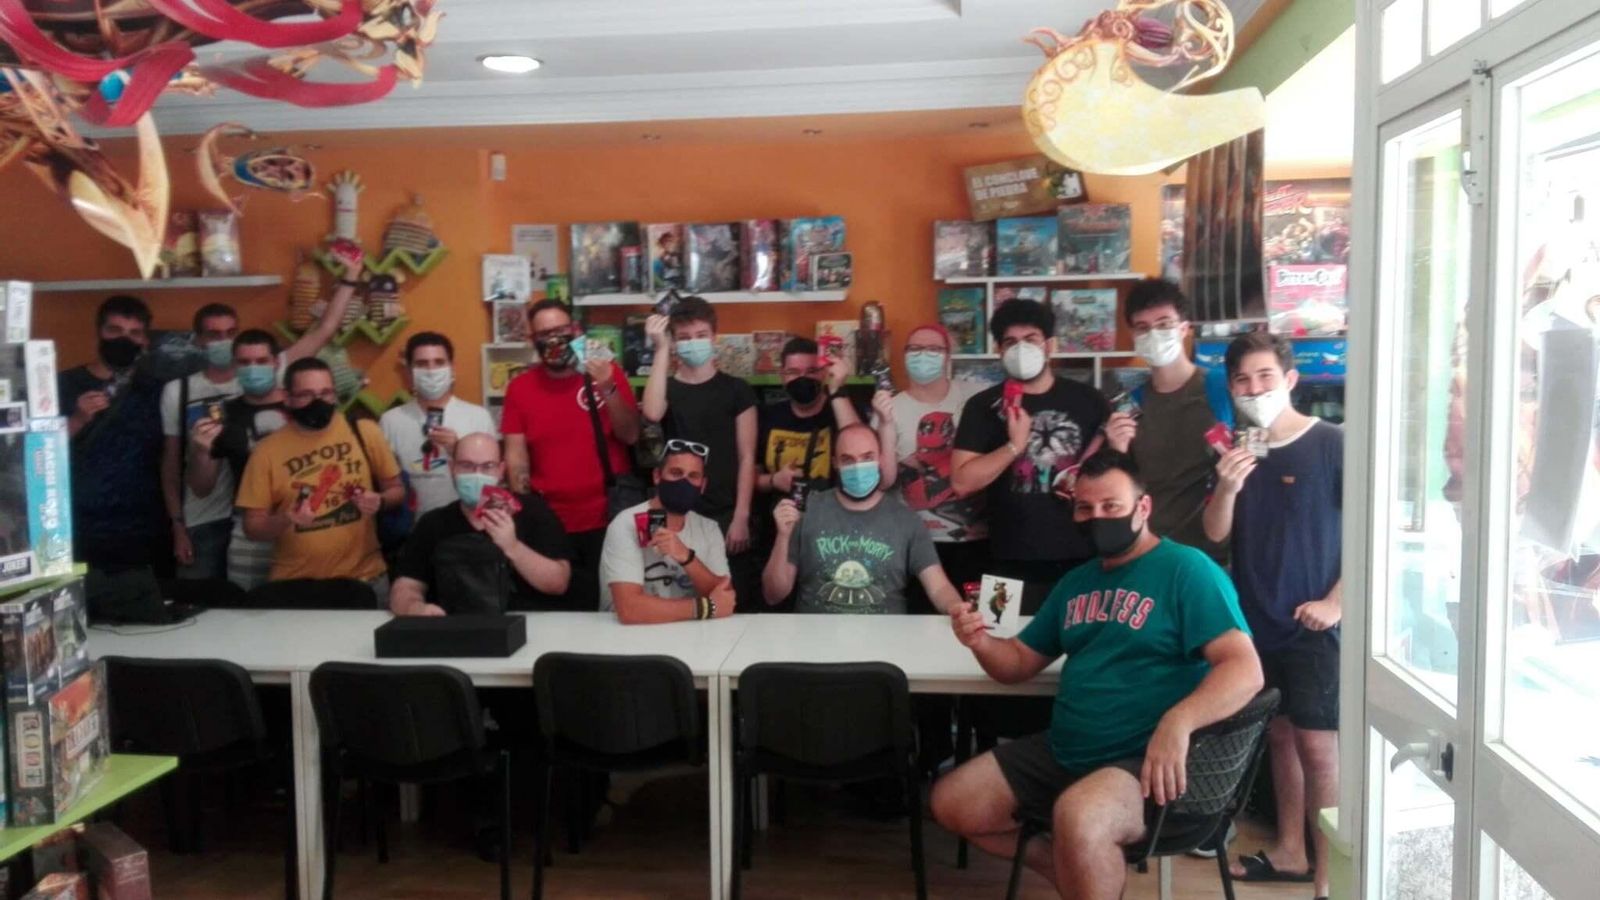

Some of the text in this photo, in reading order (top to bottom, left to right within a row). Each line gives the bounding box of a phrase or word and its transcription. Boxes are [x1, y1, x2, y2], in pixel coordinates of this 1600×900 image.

[283, 442, 351, 477] Drop
[345, 458, 362, 475] it
[816, 535, 850, 561] RICK
[858, 534, 895, 562] MORTY
[1064, 588, 1155, 630] ENDLESS
